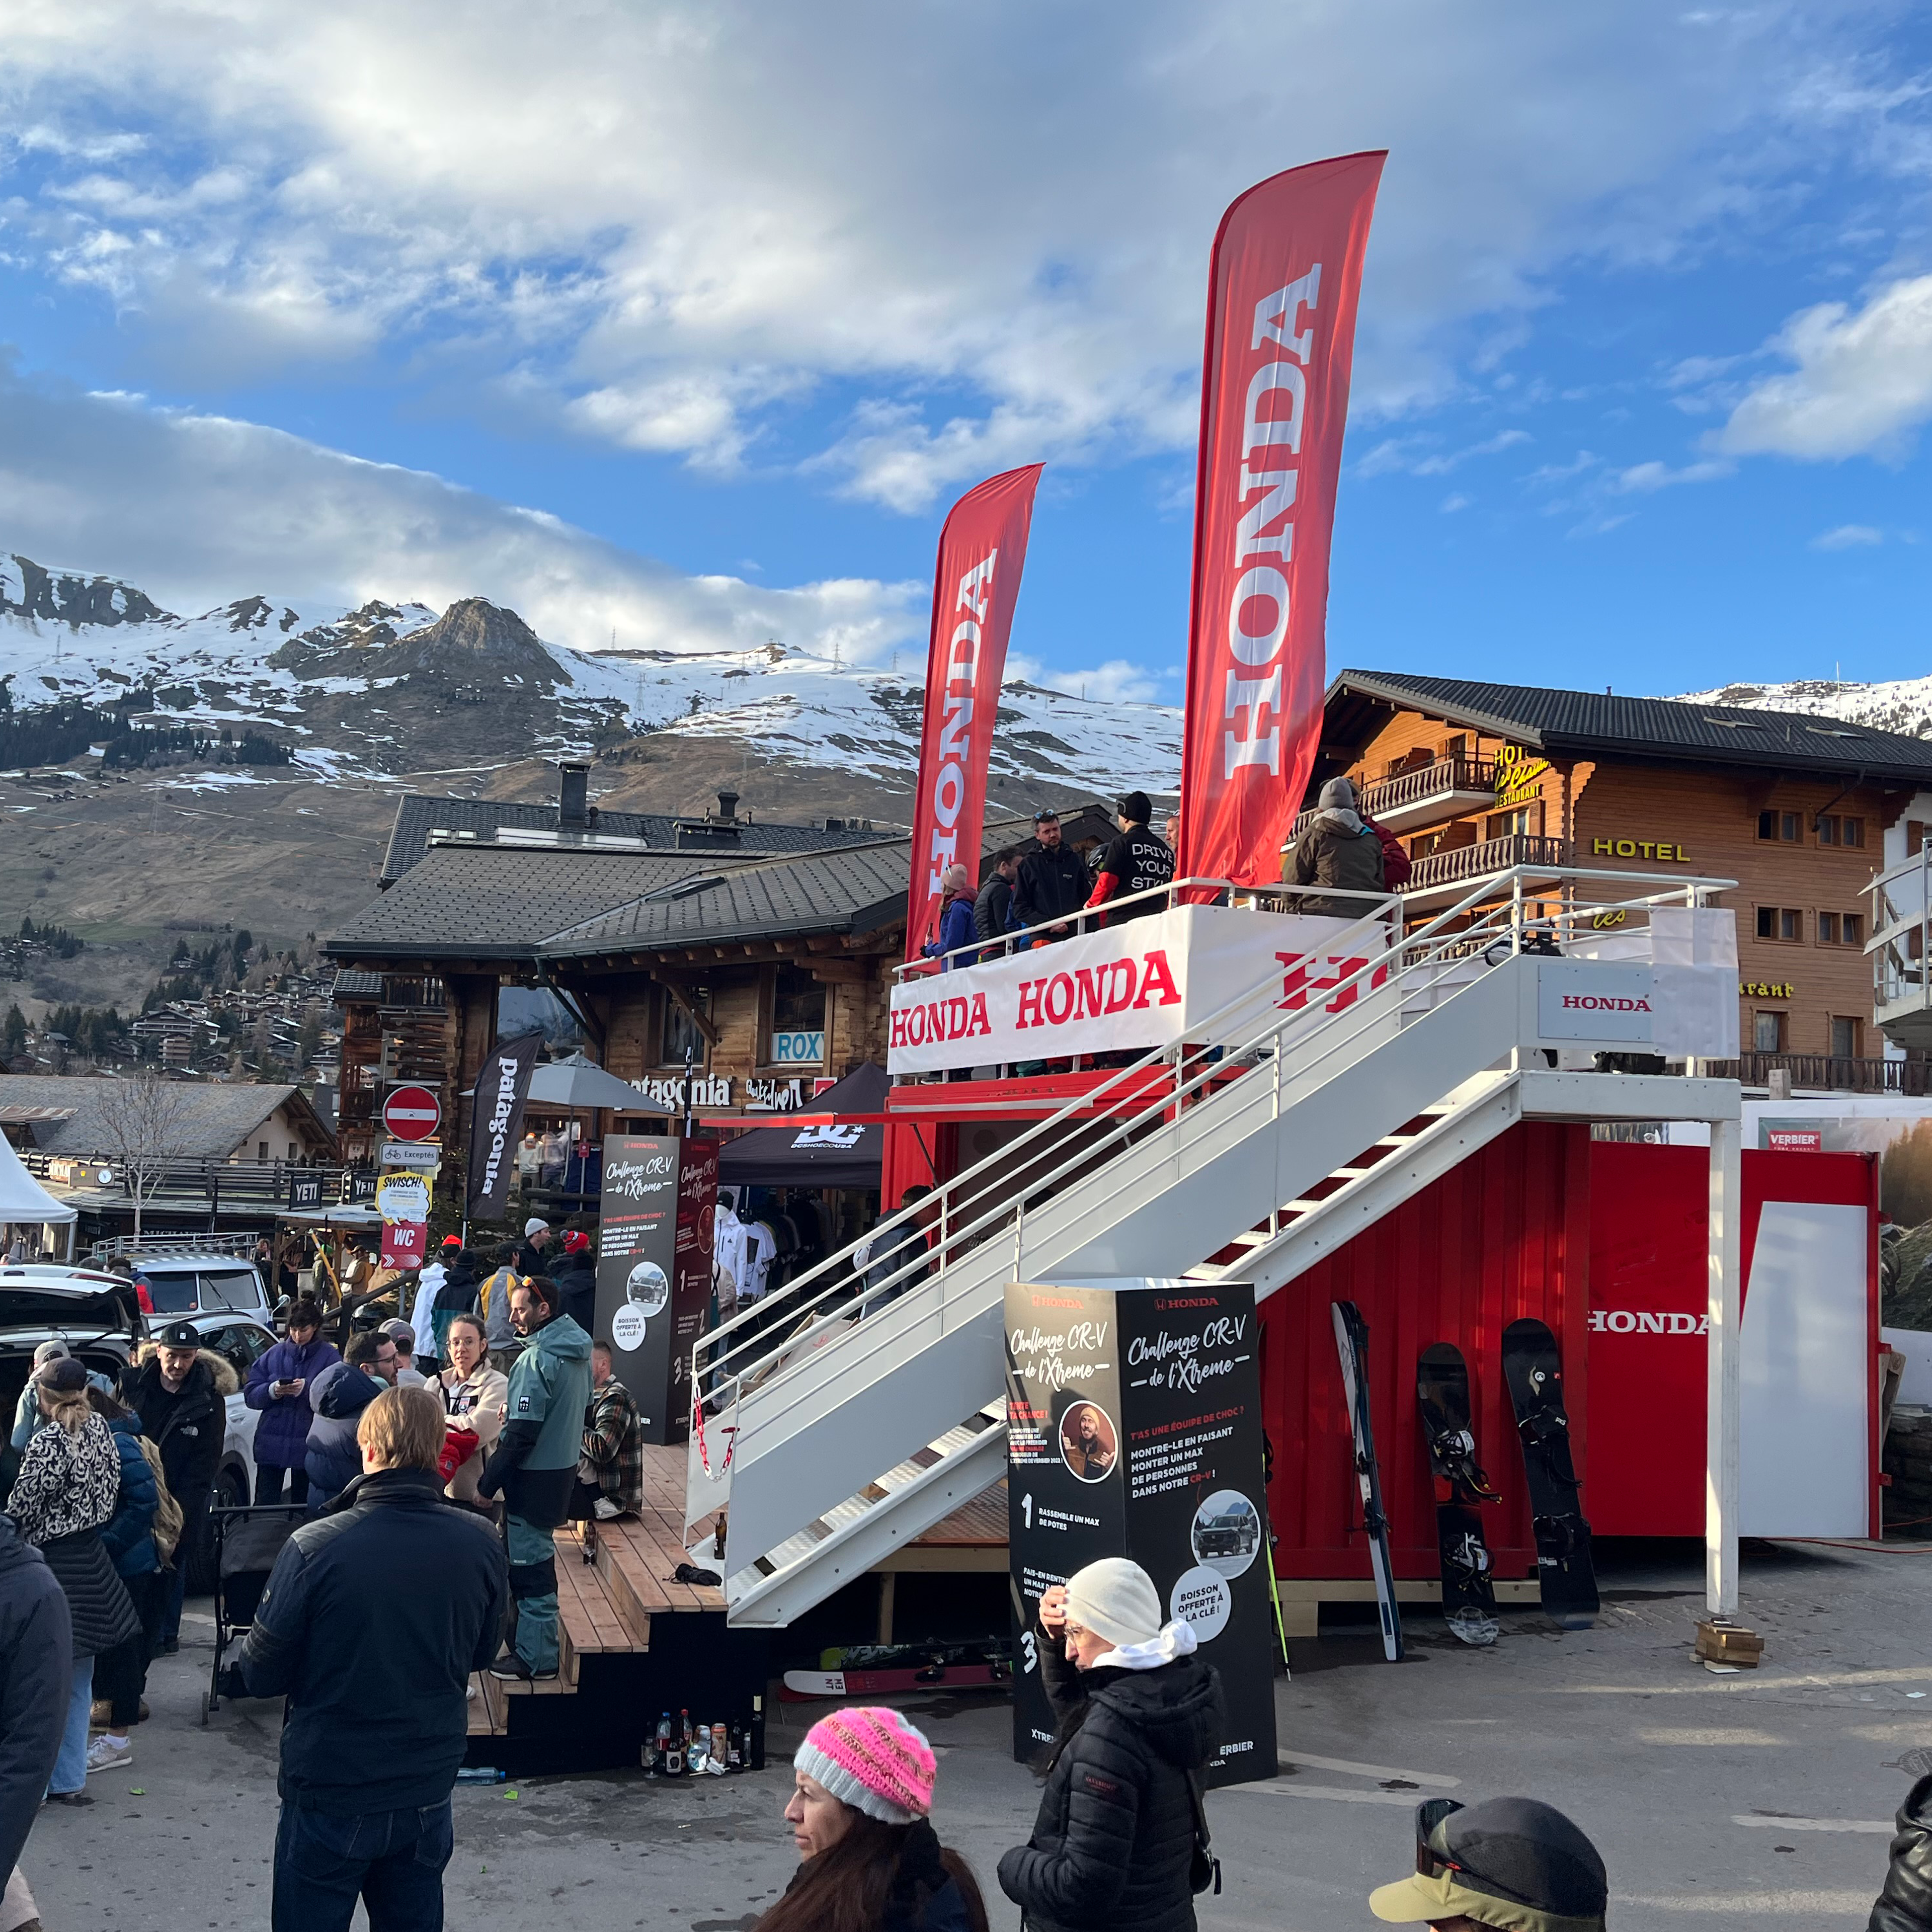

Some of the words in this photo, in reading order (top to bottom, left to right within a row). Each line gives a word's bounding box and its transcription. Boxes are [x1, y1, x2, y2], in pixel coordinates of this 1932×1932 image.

[1225, 263, 1322, 780] HONDA
[928, 548, 997, 901] HONDA
[1132, 844, 1173, 864] DRIVE
[1593, 838, 1692, 862] HOTEL
[1136, 860, 1171, 878] YOUR
[1131, 877, 1164, 890] STY
[890, 992, 992, 1049] HONDA
[1015, 950, 1181, 1030] HONDA
[1562, 996, 1652, 1012] HONDA
[778, 1033, 825, 1060] ROX
[615, 1073, 730, 1112] atagonia
[481, 1057, 518, 1195] patagonia
[1770, 1134, 1815, 1146] VERBIER
[404, 1151, 434, 1159] Exceptés
[606, 1161, 645, 1180] Challenge
[646, 1156, 674, 1175] CR-V
[296, 1182, 318, 1201] YETI
[383, 1176, 423, 1188] SWISCH!
[614, 1182, 624, 1194] de
[393, 1229, 415, 1247] WC
[608, 1241, 635, 1249] PERSONNES
[680, 1269, 685, 1292] 1
[1041, 1296, 1084, 1309] HONDA
[1167, 1297, 1219, 1309] HONDA
[1010, 1326, 1065, 1358] Challenge
[1067, 1321, 1108, 1350] CR-V
[1128, 1331, 1200, 1365] Challenge
[1202, 1314, 1247, 1348] CR-V
[1024, 1360, 1037, 1379] de
[1038, 1356, 1094, 1392] l'Xtreme
[1149, 1367, 1165, 1387] de
[1168, 1355, 1235, 1394] l'Xtreme
[1009, 1411, 1018, 1420] TA
[1018, 1410, 1044, 1419] CHANCE
[1045, 1410, 1048, 1418] !
[1131, 1429, 1150, 1441] T'AS
[1151, 1424, 1170, 1436] UNE
[1170, 1415, 1202, 1432] ÉQUIPE
[1203, 1413, 1215, 1423] DE
[1216, 1407, 1239, 1420] CHOC
[1239, 1405, 1245, 1415] ?
[1131, 1439, 1183, 1460] MONTRE-LE
[1184, 1436, 1196, 1447] EN
[1197, 1426, 1234, 1443] FAISANT
[1131, 1456, 1169, 1473] MONTER
[1170, 1452, 1183, 1463] UN
[1184, 1447, 1203, 1460] MAX
[1132, 1475, 1144, 1486] DE
[1146, 1462, 1198, 1483] PERSONNES
[1132, 1485, 1157, 1499] DANS
[1159, 1476, 1189, 1492] NOTRE
[1189, 1470, 1212, 1484] CR-V
[1212, 1469, 1216, 1478] !
[1021, 1493, 1033, 1529] 1
[1038, 1507, 1074, 1521] RASSEMBLE
[1075, 1514, 1084, 1523] UN
[1084, 1516, 1100, 1526] MAX
[1039, 1518, 1048, 1527] DE
[1048, 1519, 1067, 1531] POTES
[1023, 1567, 1046, 1580] FAIS-EN
[1024, 1577, 1032, 1586] UN
[1032, 1580, 1045, 1590] MAX
[1024, 1588, 1043, 1598] NOTRE
[1178, 1595, 1216, 1614] OFFERTE
[1218, 1591, 1224, 1602] À
[1181, 1584, 1219, 1602] BOISSON
[1185, 1612, 1197, 1622] LA
[1199, 1604, 1216, 1618] CLÉ
[1217, 1605, 1220, 1614] !
[1021, 1631, 1037, 1673] 3
[1220, 1741, 1254, 1756] ERBIER
